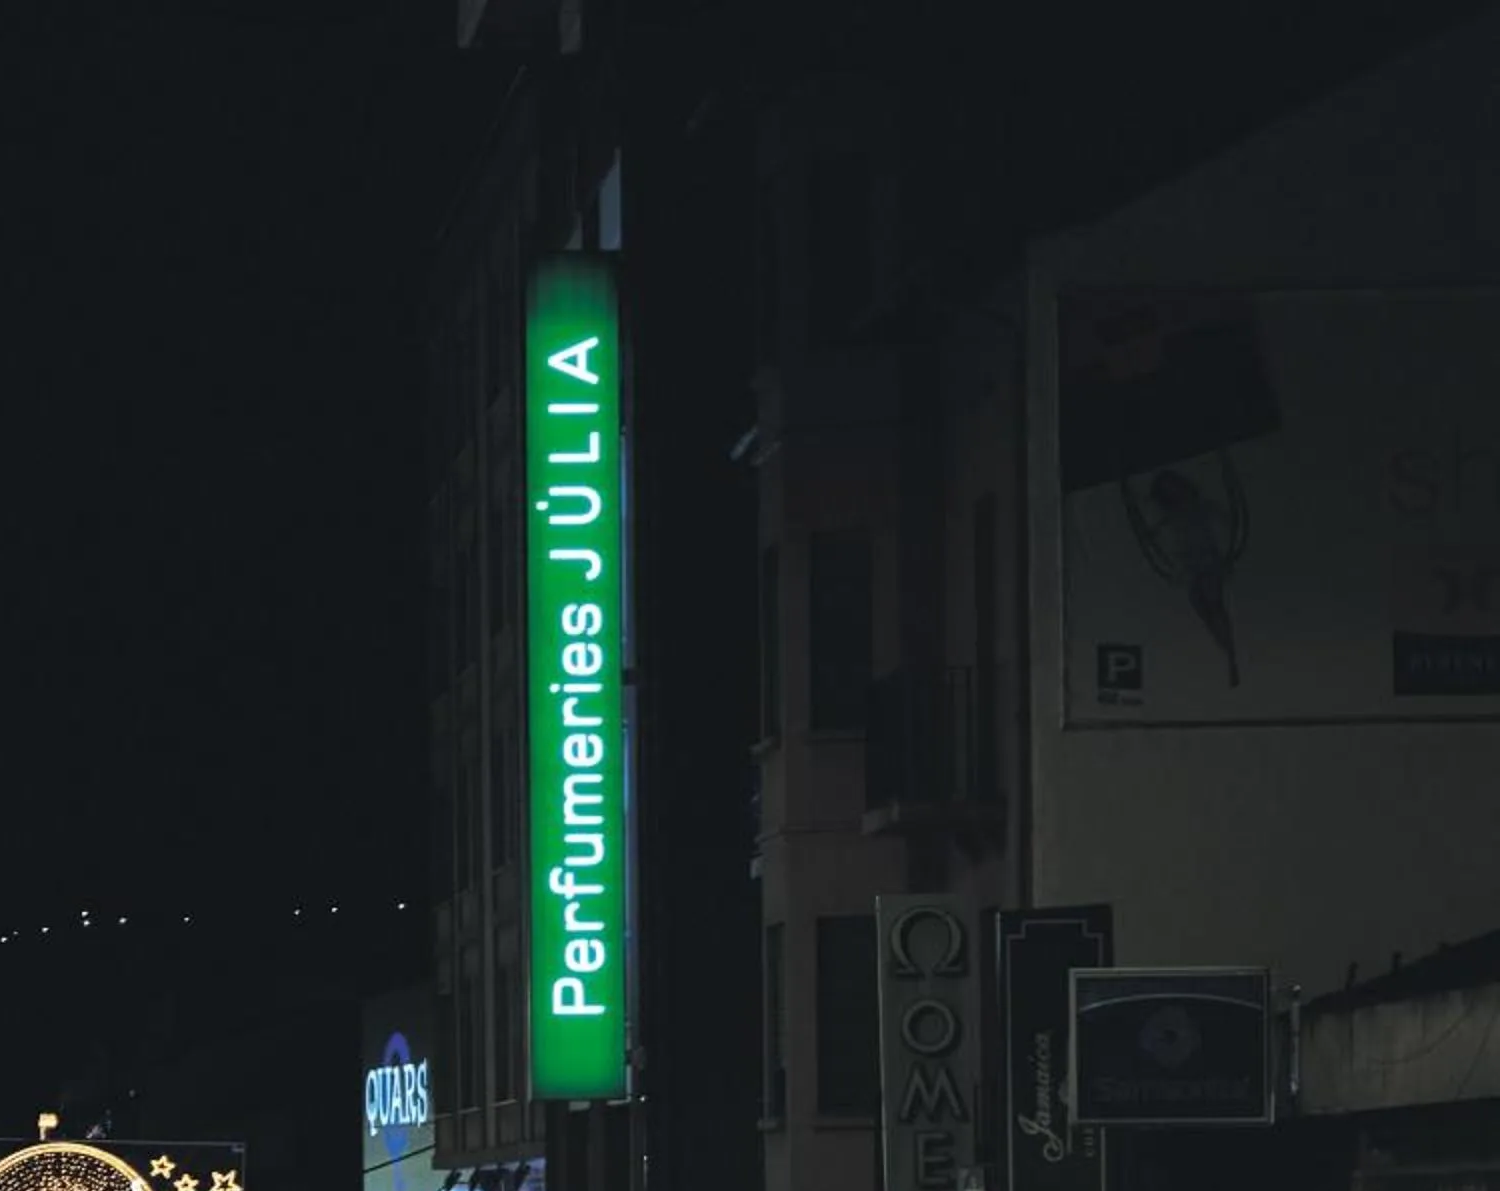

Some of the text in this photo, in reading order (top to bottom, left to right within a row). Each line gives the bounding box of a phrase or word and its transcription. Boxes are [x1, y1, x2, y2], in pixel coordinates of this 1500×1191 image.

[549, 603, 605, 1015] Perfumeries
[365, 1060, 428, 1136] QUARS
[1018, 1032, 1064, 1161] Jamaica
